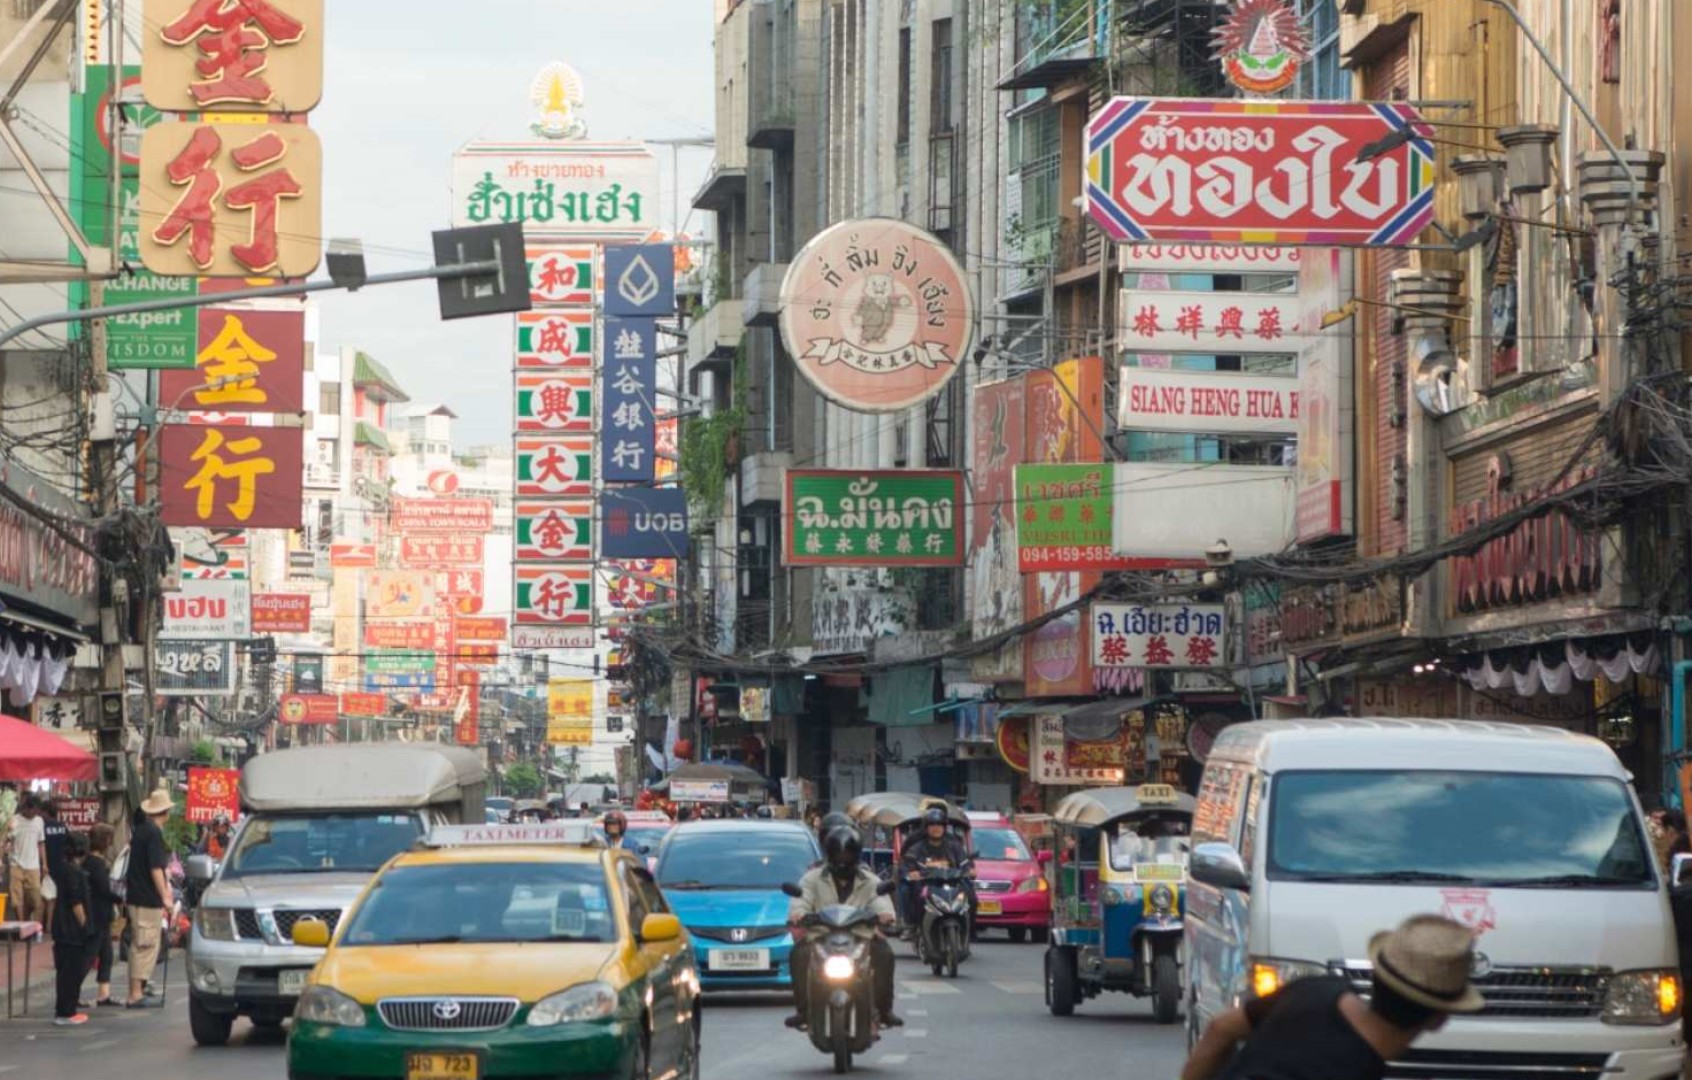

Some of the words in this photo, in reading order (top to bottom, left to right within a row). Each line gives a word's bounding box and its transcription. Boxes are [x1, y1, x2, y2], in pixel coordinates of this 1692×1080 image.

[153, 0, 305, 272] 金行
[1140, 115, 1276, 151] ห้างทอง
[508, 160, 605, 178] ห้างขายทอง
[1122, 125, 1400, 220] ทองใบ
[467, 171, 642, 223] ฮั่วเซ่งเฮง
[1132, 305, 1300, 340] 林祥興藥
[107, 344, 186, 358] ISDOM
[184, 314, 278, 521] 金行
[1131, 385, 1186, 415] SIANG
[1191, 388, 1240, 417] HENG
[1246, 390, 1284, 418] HUA
[634, 513, 685, 532] UOB
[1143, 788, 1172, 797] TAXI
[462, 828, 502, 840] TAXI
[505, 827, 567, 840] METER
[444, 1055, 471, 1072] 723
